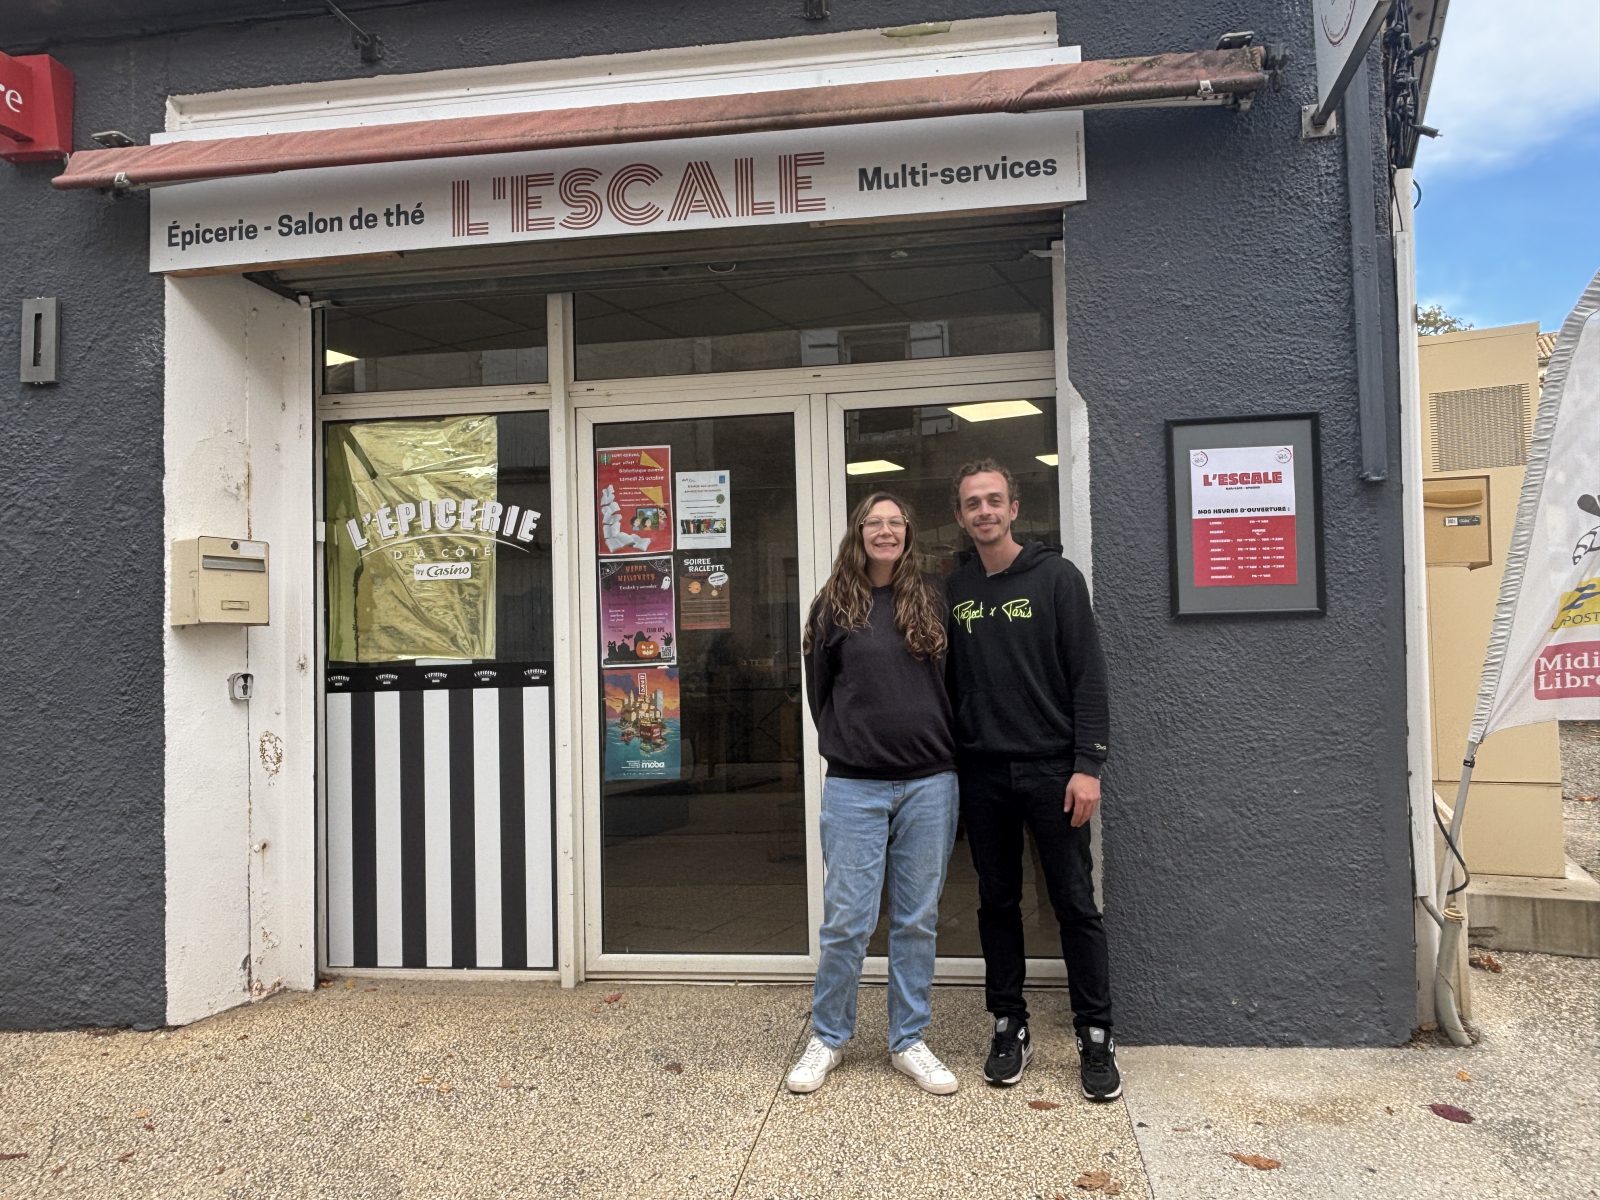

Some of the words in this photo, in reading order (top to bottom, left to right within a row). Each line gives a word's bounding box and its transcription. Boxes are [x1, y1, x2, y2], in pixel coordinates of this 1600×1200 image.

[0, 83, 22, 113] e
[858, 155, 1058, 192] Multi-services
[451, 151, 826, 238] L'ESCALE
[167, 220, 258, 251] Épicerie
[277, 210, 343, 238] Salon
[350, 207, 378, 231] de
[384, 202, 425, 227] thé
[1202, 471, 1283, 487] L'ESCALE
[1240, 506, 1287, 514] D'OUVERTURE
[346, 498, 541, 550] L'ÉPICERIE
[441, 544, 491, 558] CÔTÉ
[426, 564, 470, 578] Casino
[688, 565, 725, 573] RACLETTE
[952, 600, 984, 634] Project
[1001, 598, 1032, 623] Paris
[1538, 651, 1600, 673] Midi
